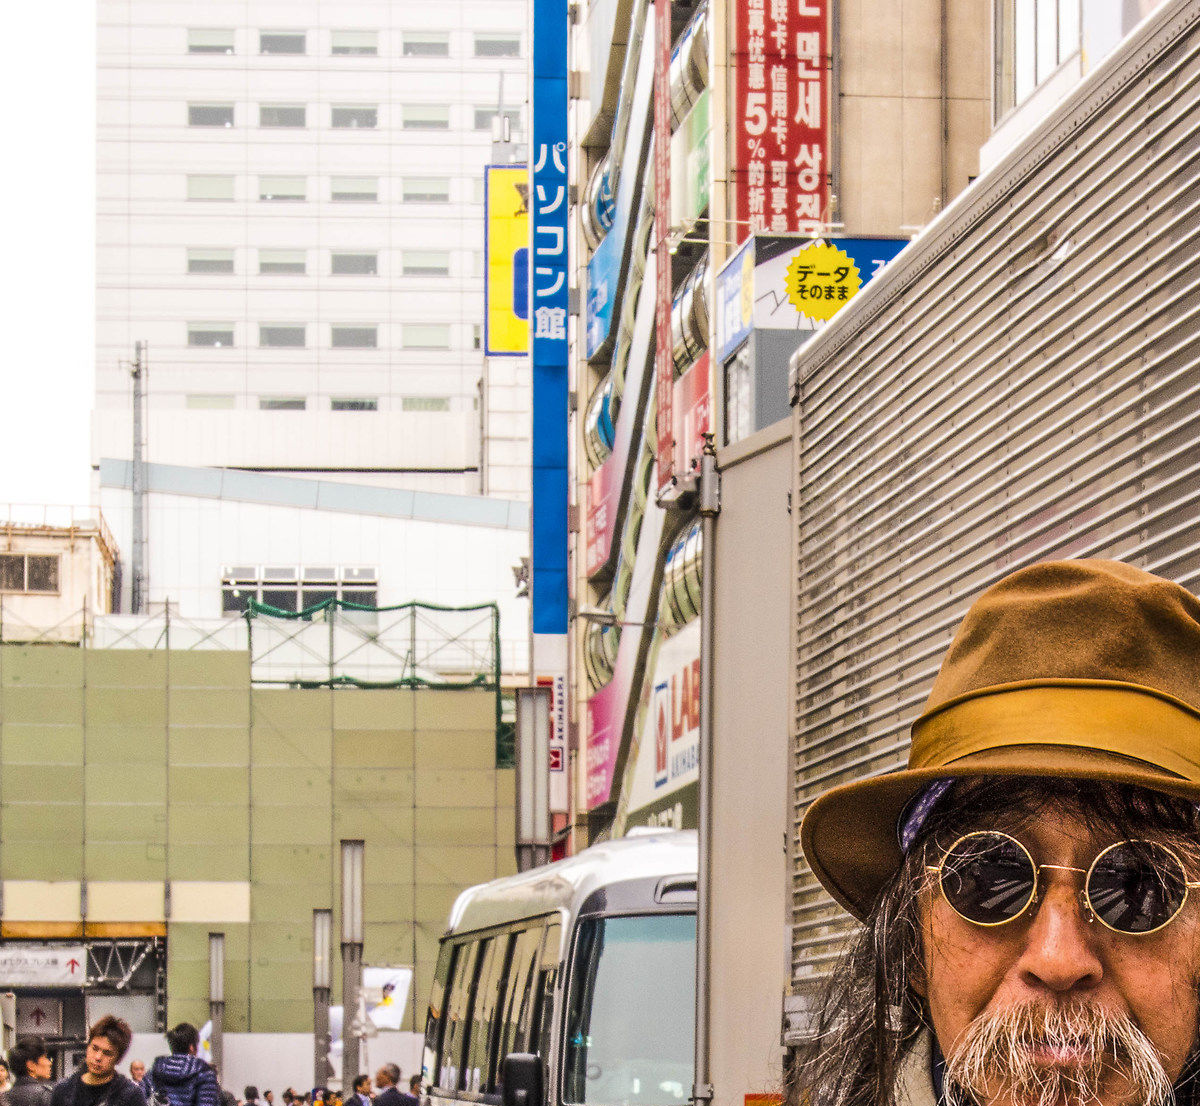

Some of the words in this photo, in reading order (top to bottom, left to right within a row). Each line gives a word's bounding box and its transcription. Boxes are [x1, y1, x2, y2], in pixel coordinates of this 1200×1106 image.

[534, 141, 567, 340] パソコン館
[797, 265, 850, 283] データ
[796, 284, 849, 301] そのまま
